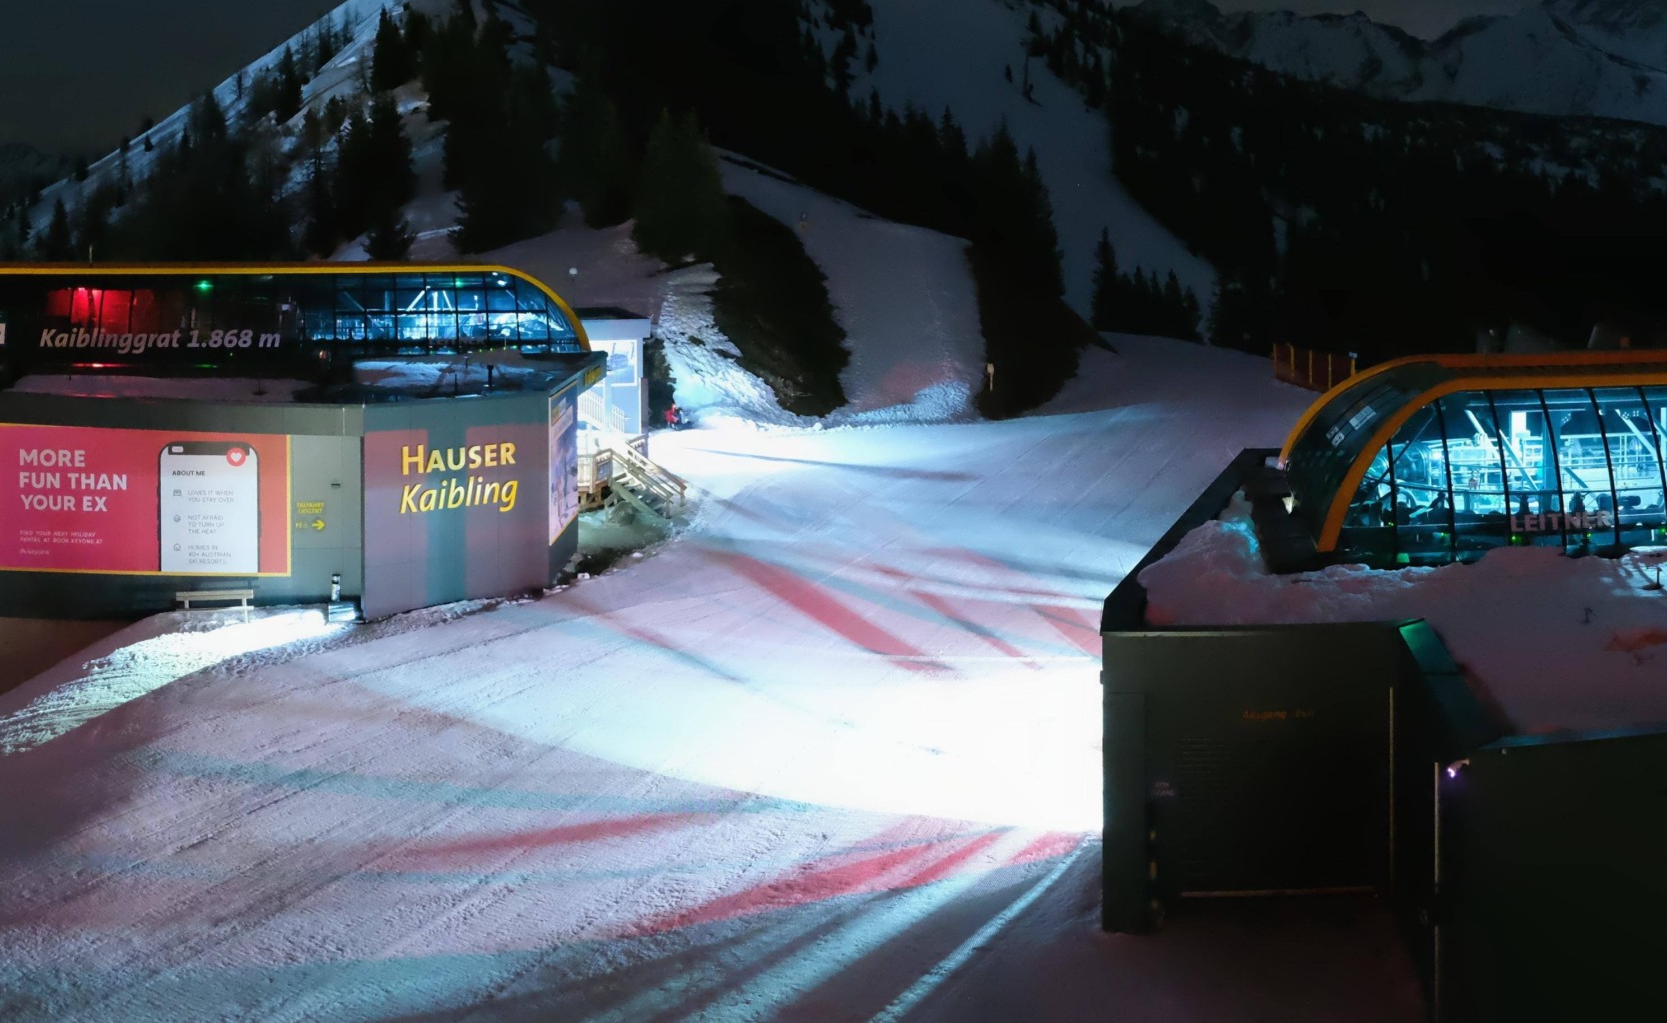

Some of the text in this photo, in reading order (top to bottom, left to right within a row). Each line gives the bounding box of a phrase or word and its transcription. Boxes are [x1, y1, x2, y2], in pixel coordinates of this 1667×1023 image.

[39, 327, 280, 354] Kaiblinggrat 1.868 m
[19, 449, 86, 467] MORE
[402, 442, 516, 475] HAUSER
[19, 471, 128, 490] FUN THAN
[20, 494, 108, 512] YOUR EX
[400, 476, 518, 514] Kaibling
[1510, 510, 1611, 532] LEITNER
